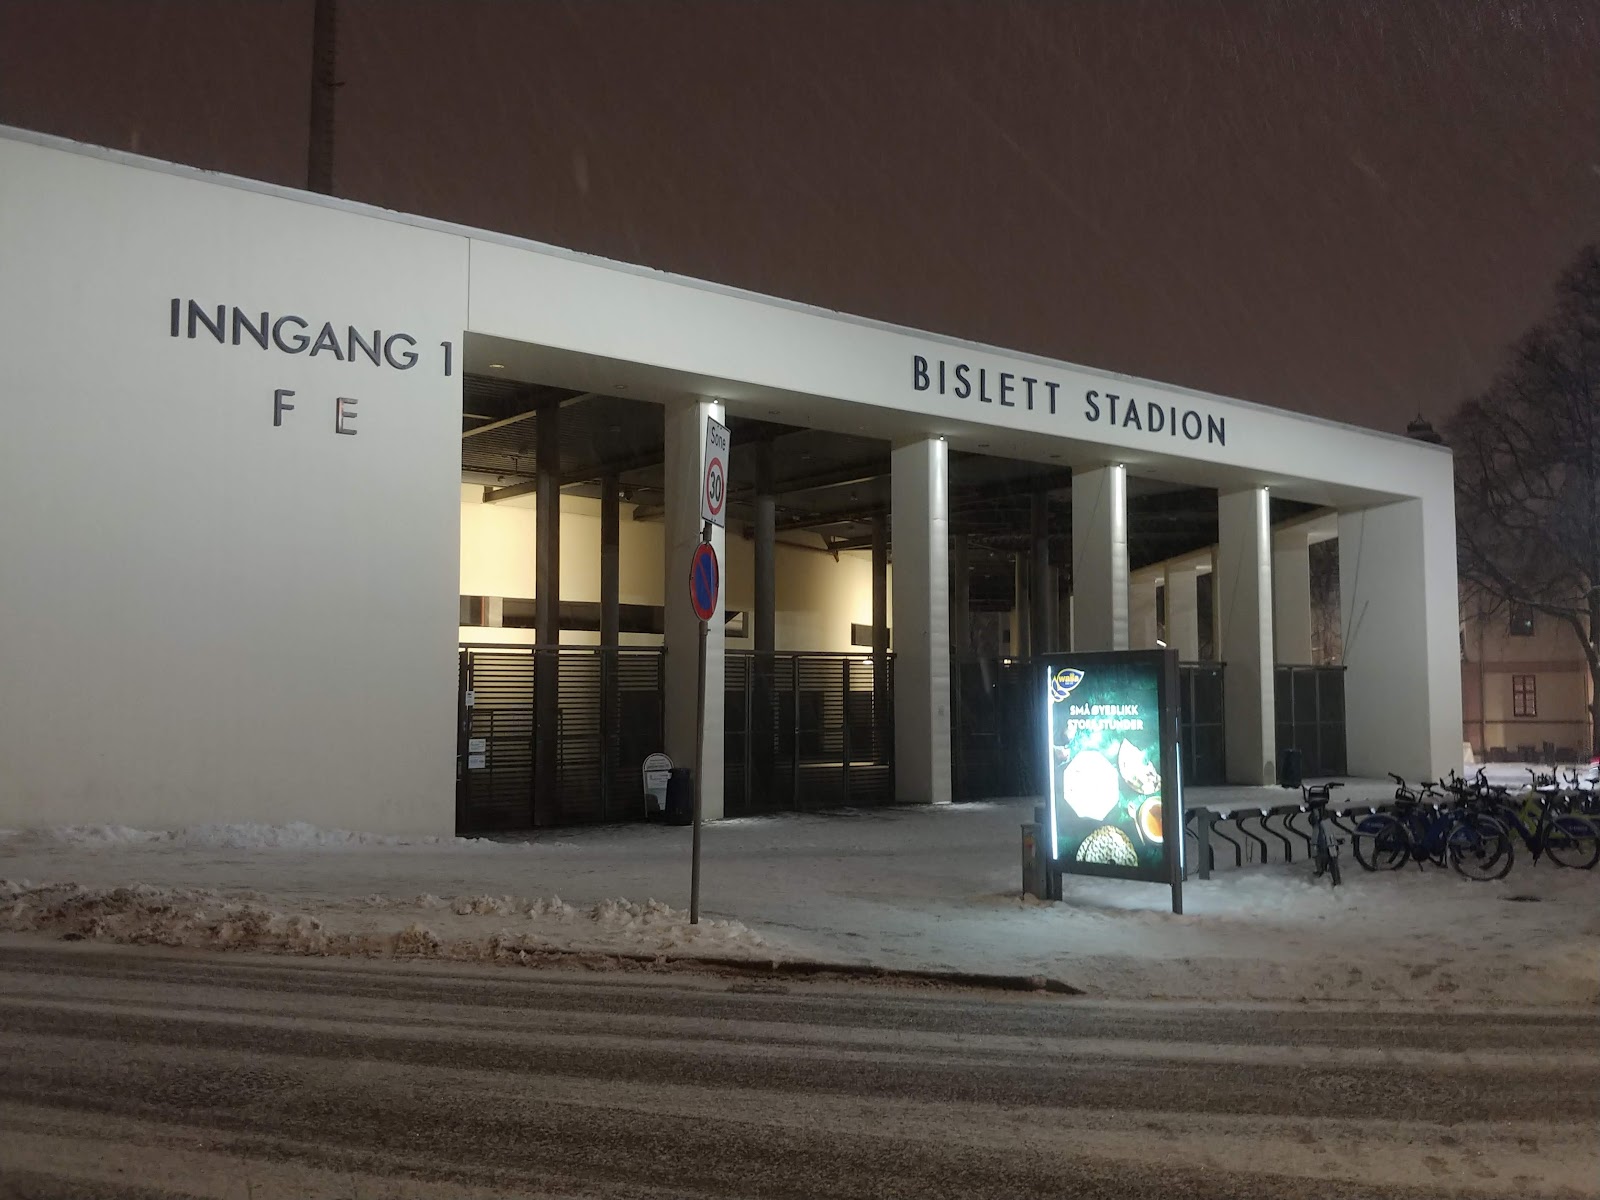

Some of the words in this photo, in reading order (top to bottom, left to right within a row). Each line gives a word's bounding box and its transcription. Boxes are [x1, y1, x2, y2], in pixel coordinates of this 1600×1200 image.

[170, 298, 419, 370] INNGANG
[440, 341, 452, 376] 1
[273, 389, 296, 427] F
[336, 397, 358, 435] E
[914, 355, 1060, 414] BISLETT
[1085, 390, 1226, 446] STADION
[711, 426, 725, 450] Sone
[710, 471, 721, 501] 30
[1070, 703, 1090, 715] SMÅ
